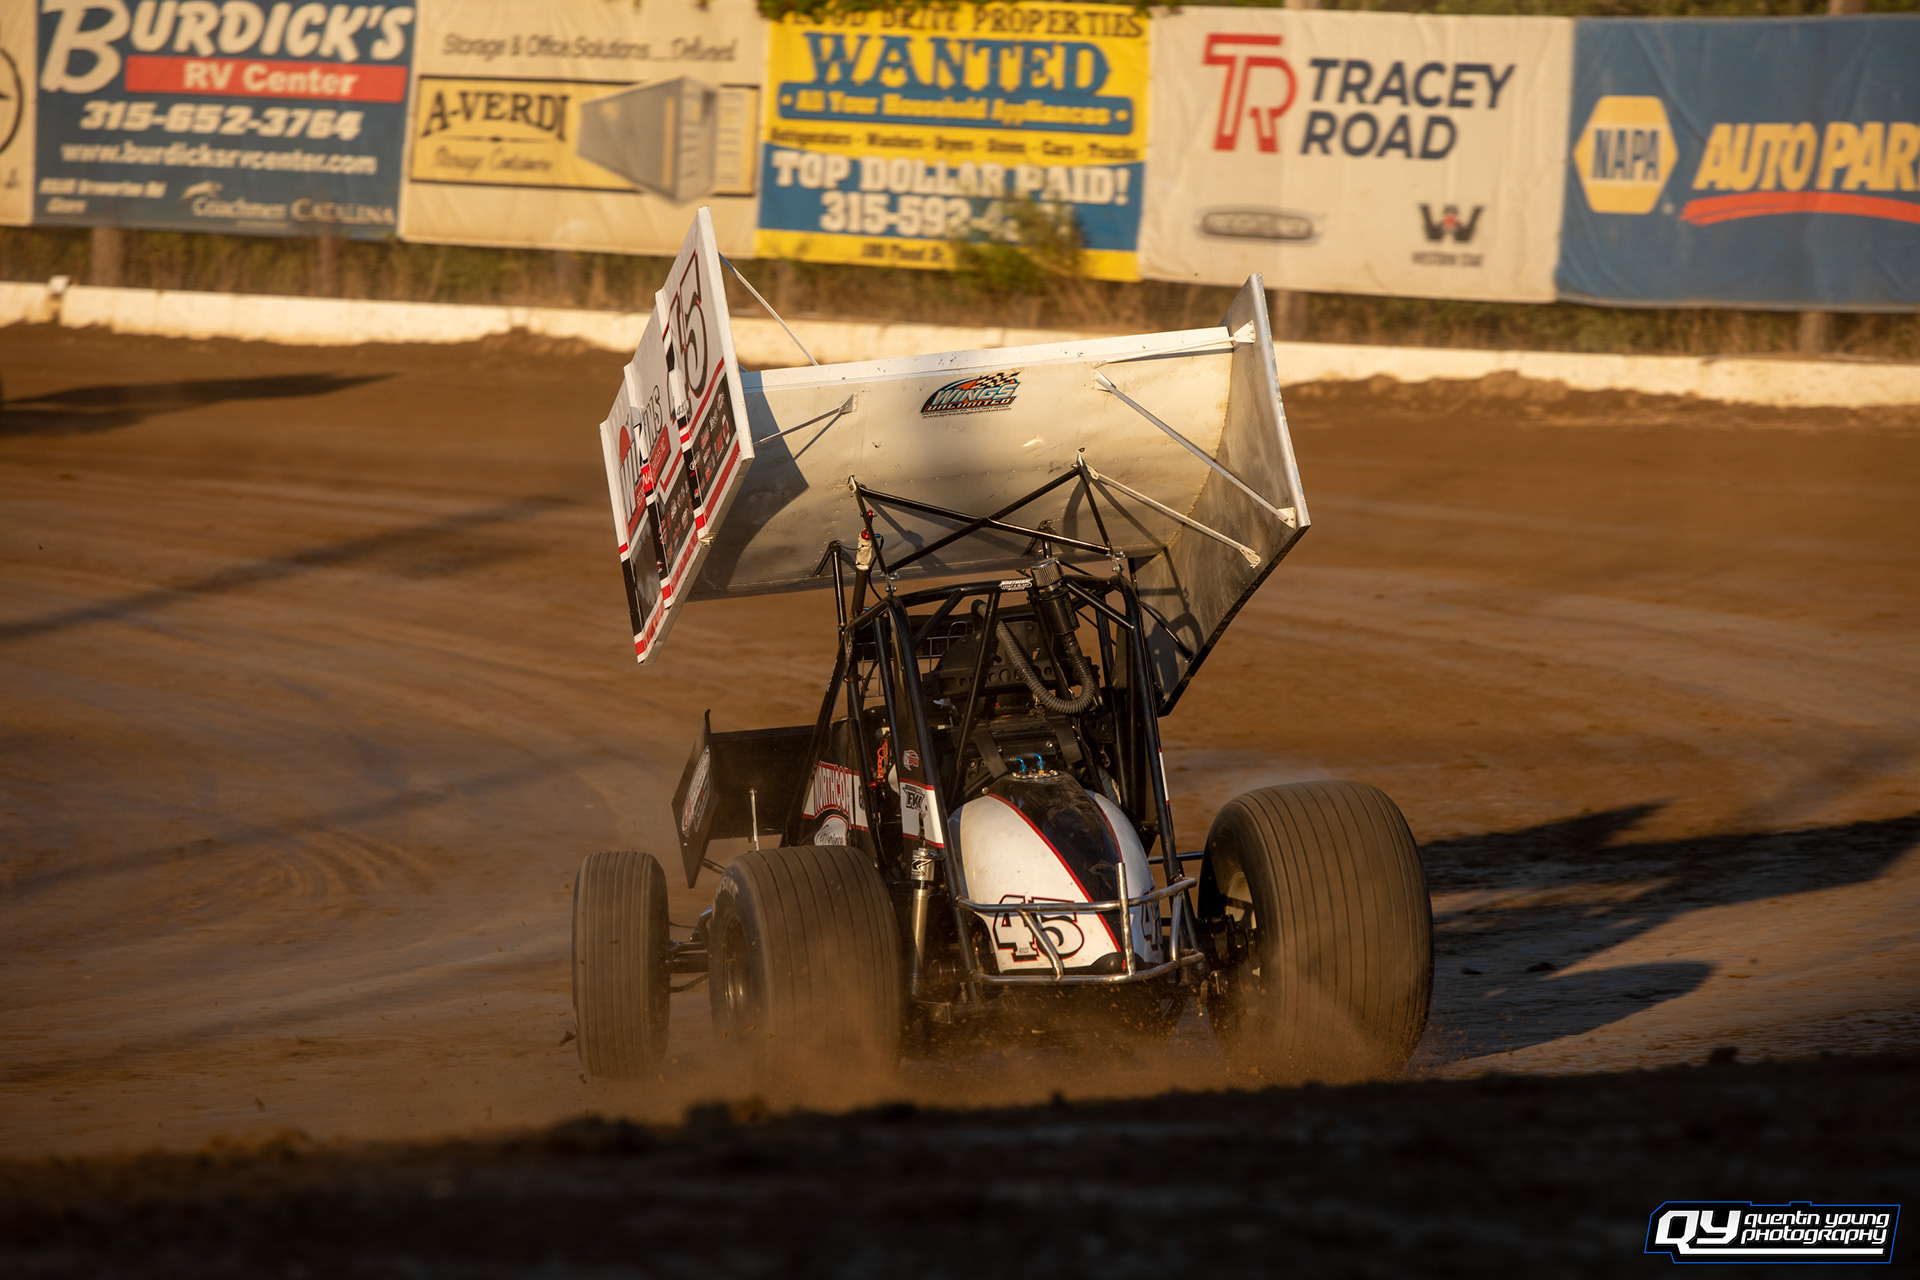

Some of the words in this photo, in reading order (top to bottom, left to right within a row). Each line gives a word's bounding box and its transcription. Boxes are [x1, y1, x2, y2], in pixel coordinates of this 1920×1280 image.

[40, 0, 414, 93] BURDICK'S
[974, 7, 1144, 37] PROPERTIES
[184, 61, 236, 90] RV
[242, 63, 359, 96] Center
[802, 32, 1111, 93] WANTED
[1309, 58, 1516, 109] TRACEY
[79, 101, 365, 140] 315-652-3764
[421, 91, 571, 142] A-VERDI
[1299, 110, 1458, 160] ROAD
[771, 150, 850, 189] TOP
[859, 156, 1006, 198] DOLLAR
[1014, 163, 1131, 206] PAID!
[1592, 129, 1660, 181] NAPA
[1691, 122, 1819, 191] AUTO
[1815, 121, 1920, 192] PAR
[926, 397, 1012, 411] UNLIMITED
[930, 382, 1020, 406] WINGS
[993, 894, 1084, 962] 45
